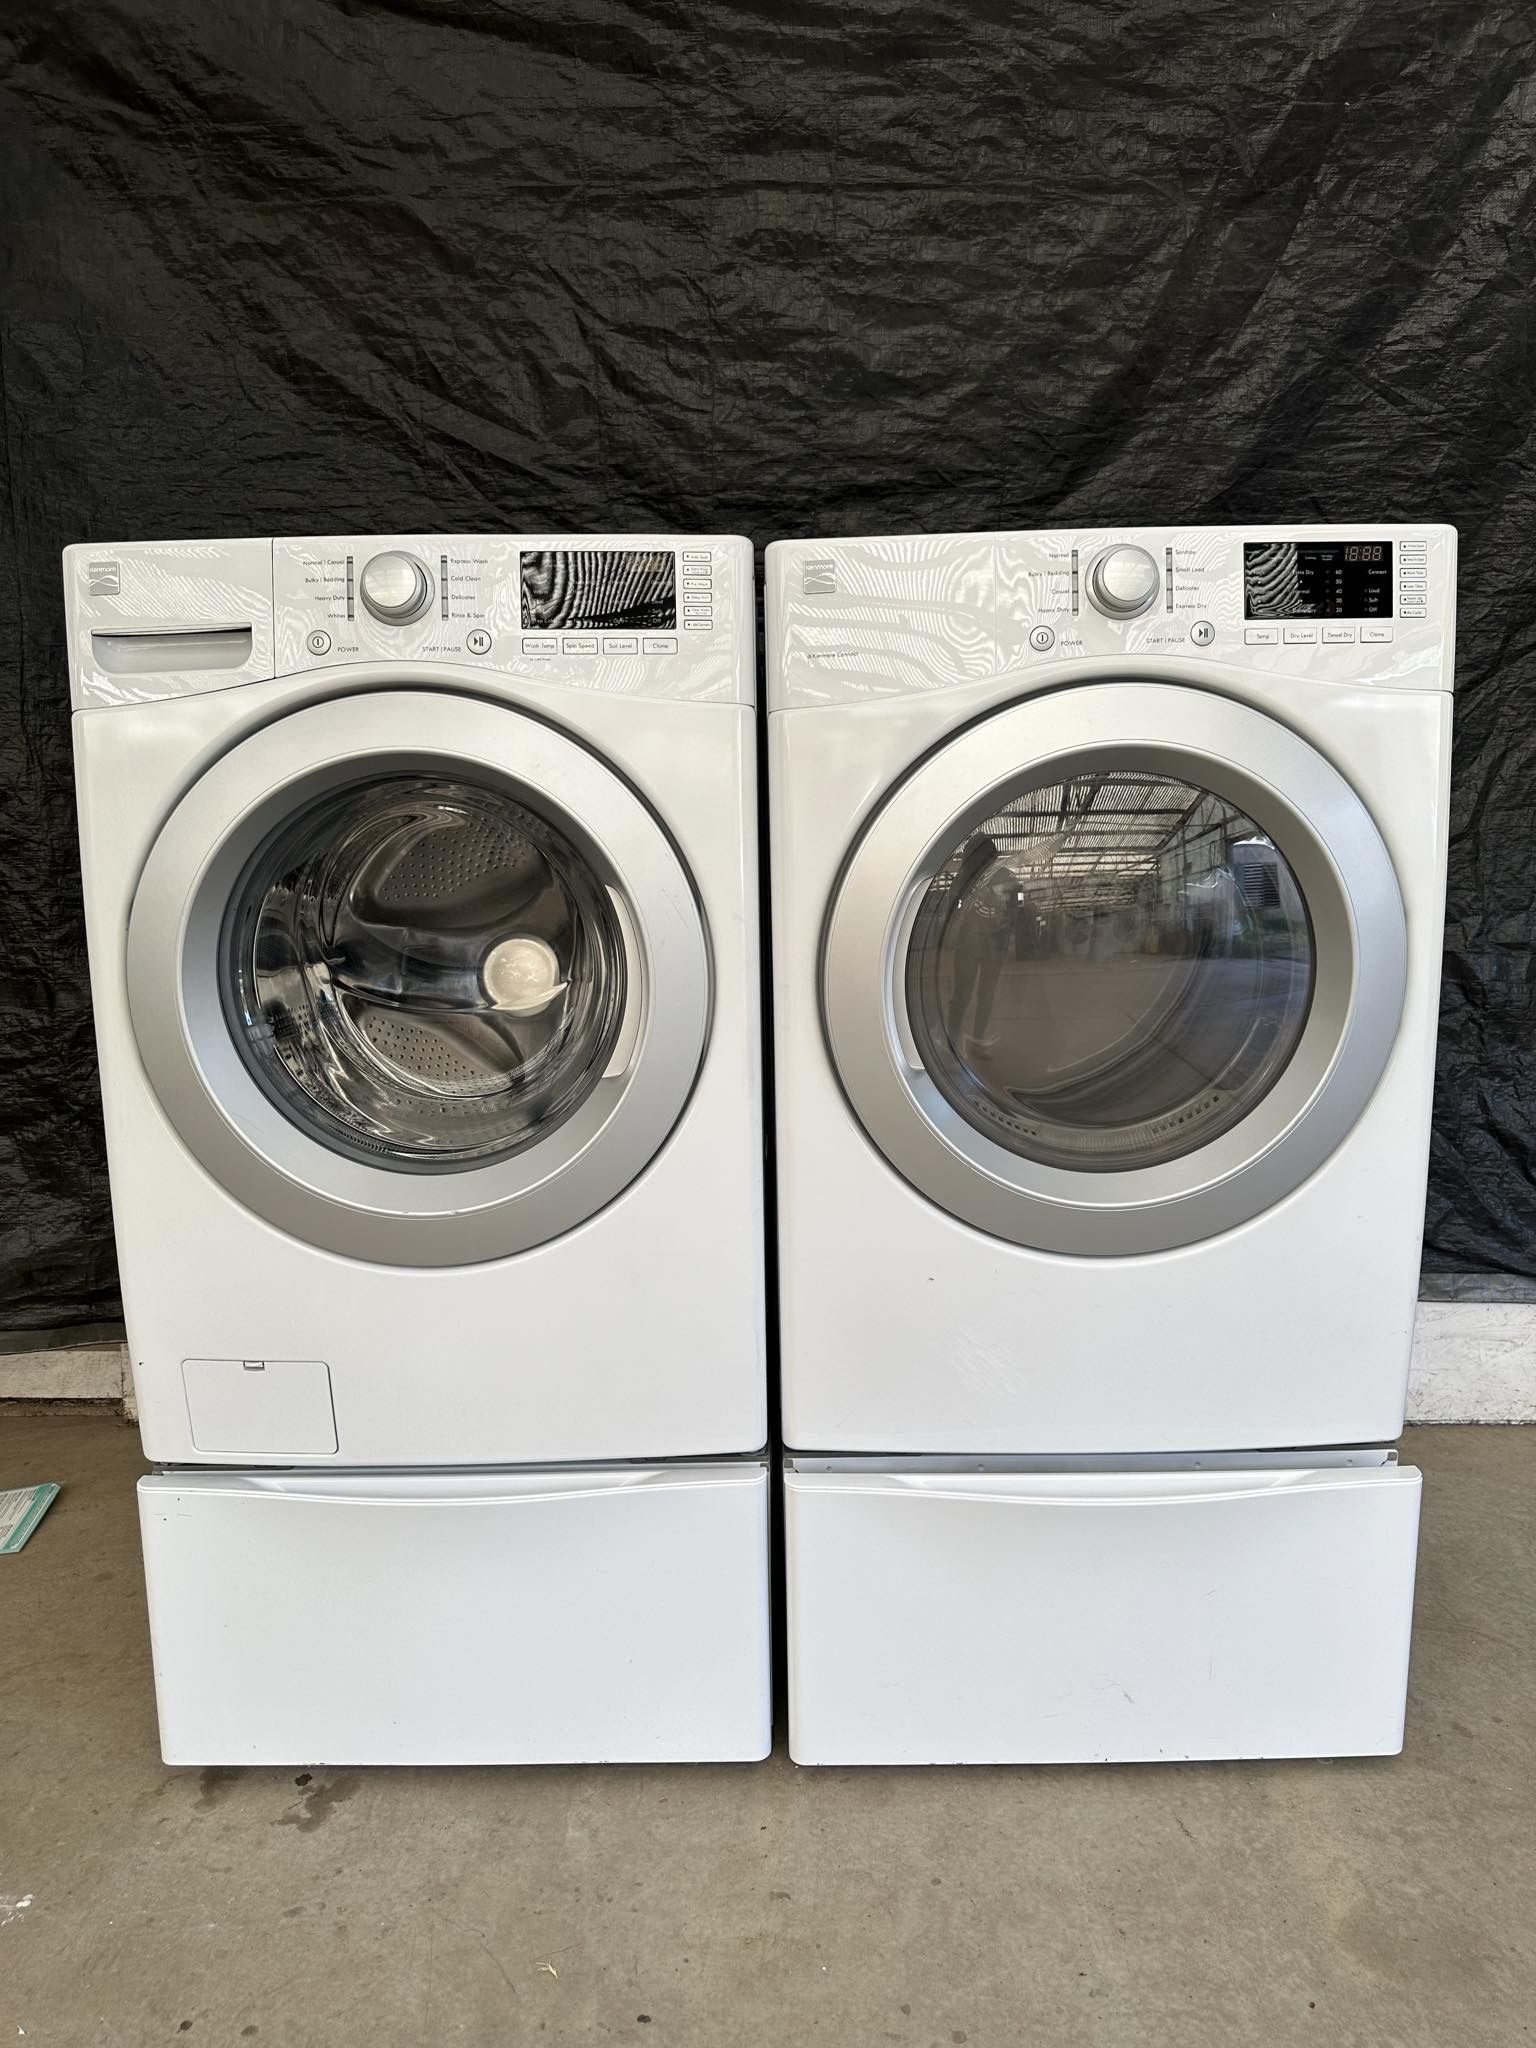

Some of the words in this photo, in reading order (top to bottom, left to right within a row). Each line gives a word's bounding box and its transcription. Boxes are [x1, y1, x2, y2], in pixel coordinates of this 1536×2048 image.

[1256, 632, 1270, 640] Temp
[1290, 632, 1300, 640] Dry
[1300, 631, 1314, 639] Level
[1342, 631, 1353, 639] Dry
[541, 642, 556, 650] Temp
[566, 642, 578, 650] Spin
[579, 642, 596, 650] Speed
[836, 651, 859, 659] Connect
